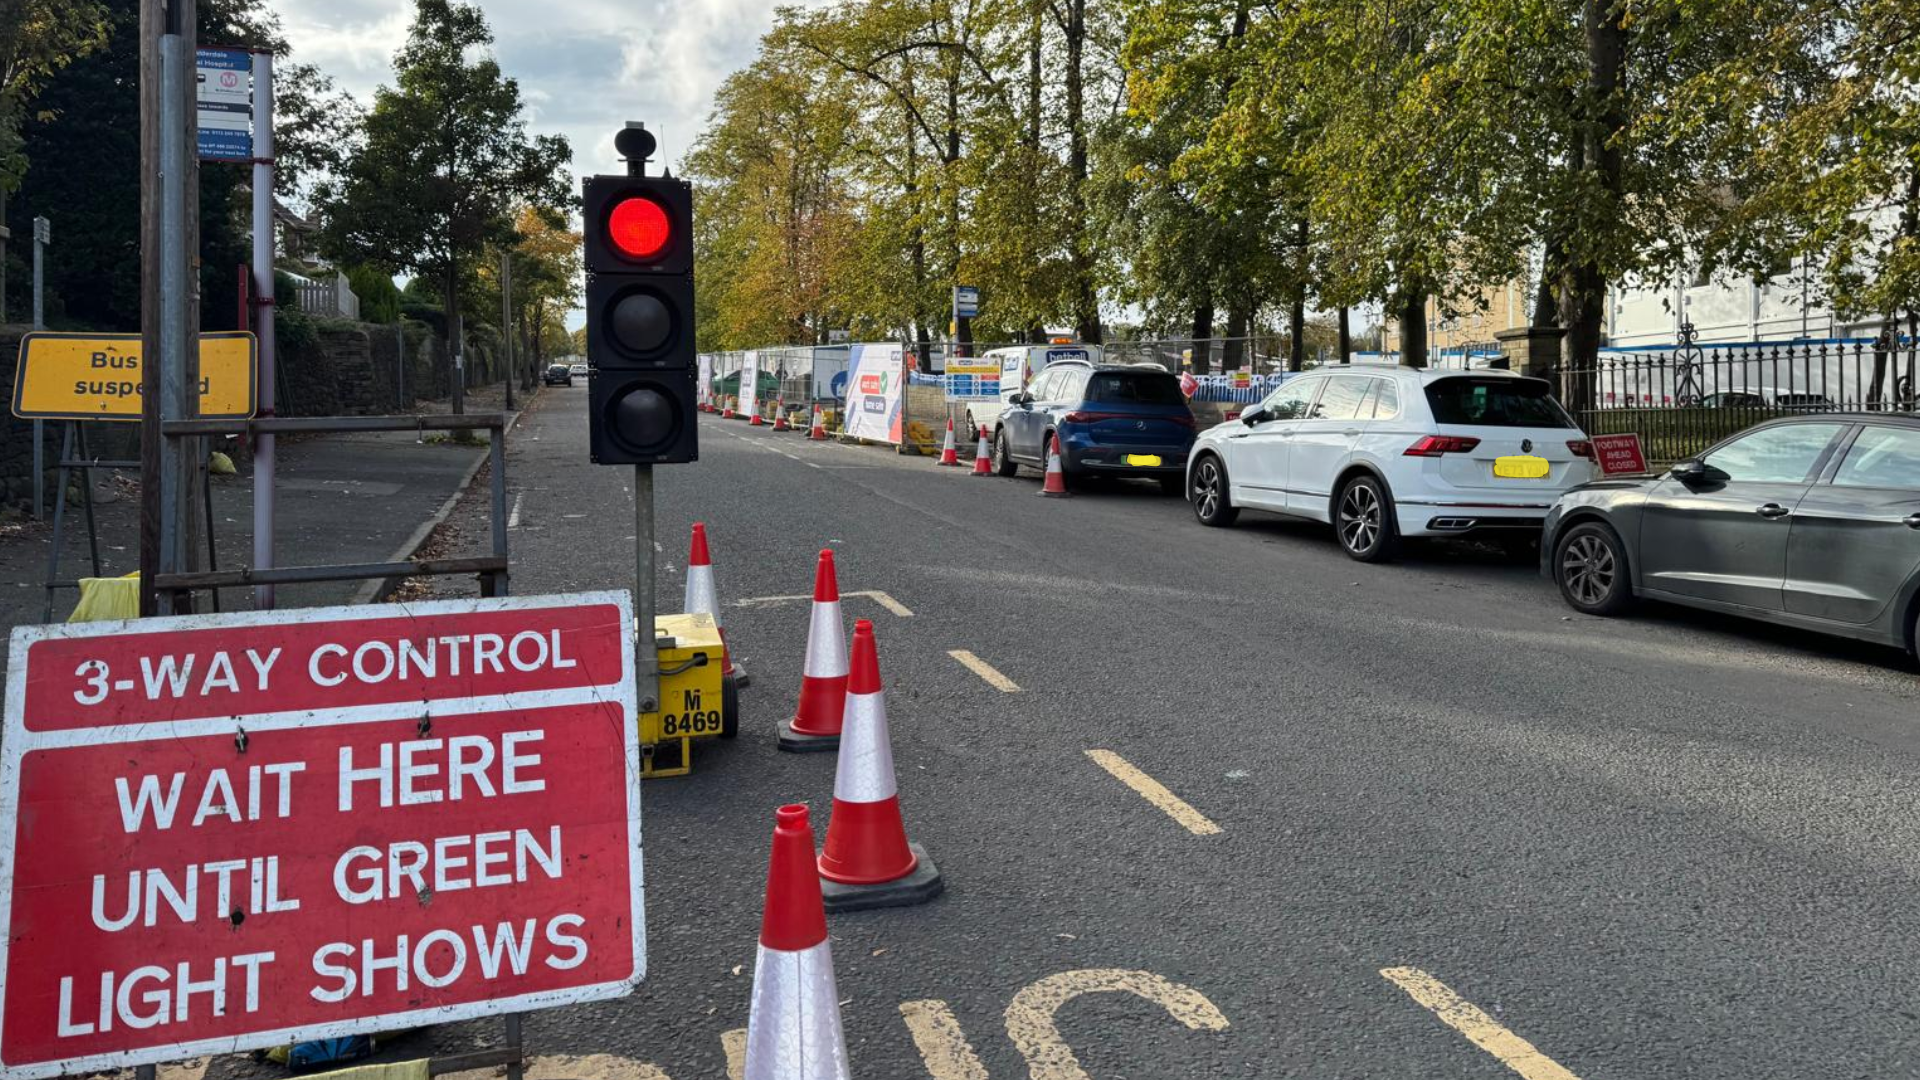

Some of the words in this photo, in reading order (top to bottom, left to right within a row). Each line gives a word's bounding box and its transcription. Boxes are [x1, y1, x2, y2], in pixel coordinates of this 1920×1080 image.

[91, 352, 138, 368] Bus
[1596, 439, 1635, 449] FOOTWAY
[1606, 450, 1631, 459] AHEAD
[1607, 460, 1637, 470] CLOSED
[74, 648, 282, 706] 3-WAY
[308, 628, 577, 687] CONTROL
[684, 690, 701, 711] M
[664, 711, 720, 735] 8469
[115, 761, 306, 834] WAIT
[339, 729, 546, 812] HERE
[92, 855, 300, 932] UNTIL
[333, 824, 563, 906] GREEN
[58, 951, 276, 1038] LIGHT
[309, 912, 589, 1004] SHOWS
